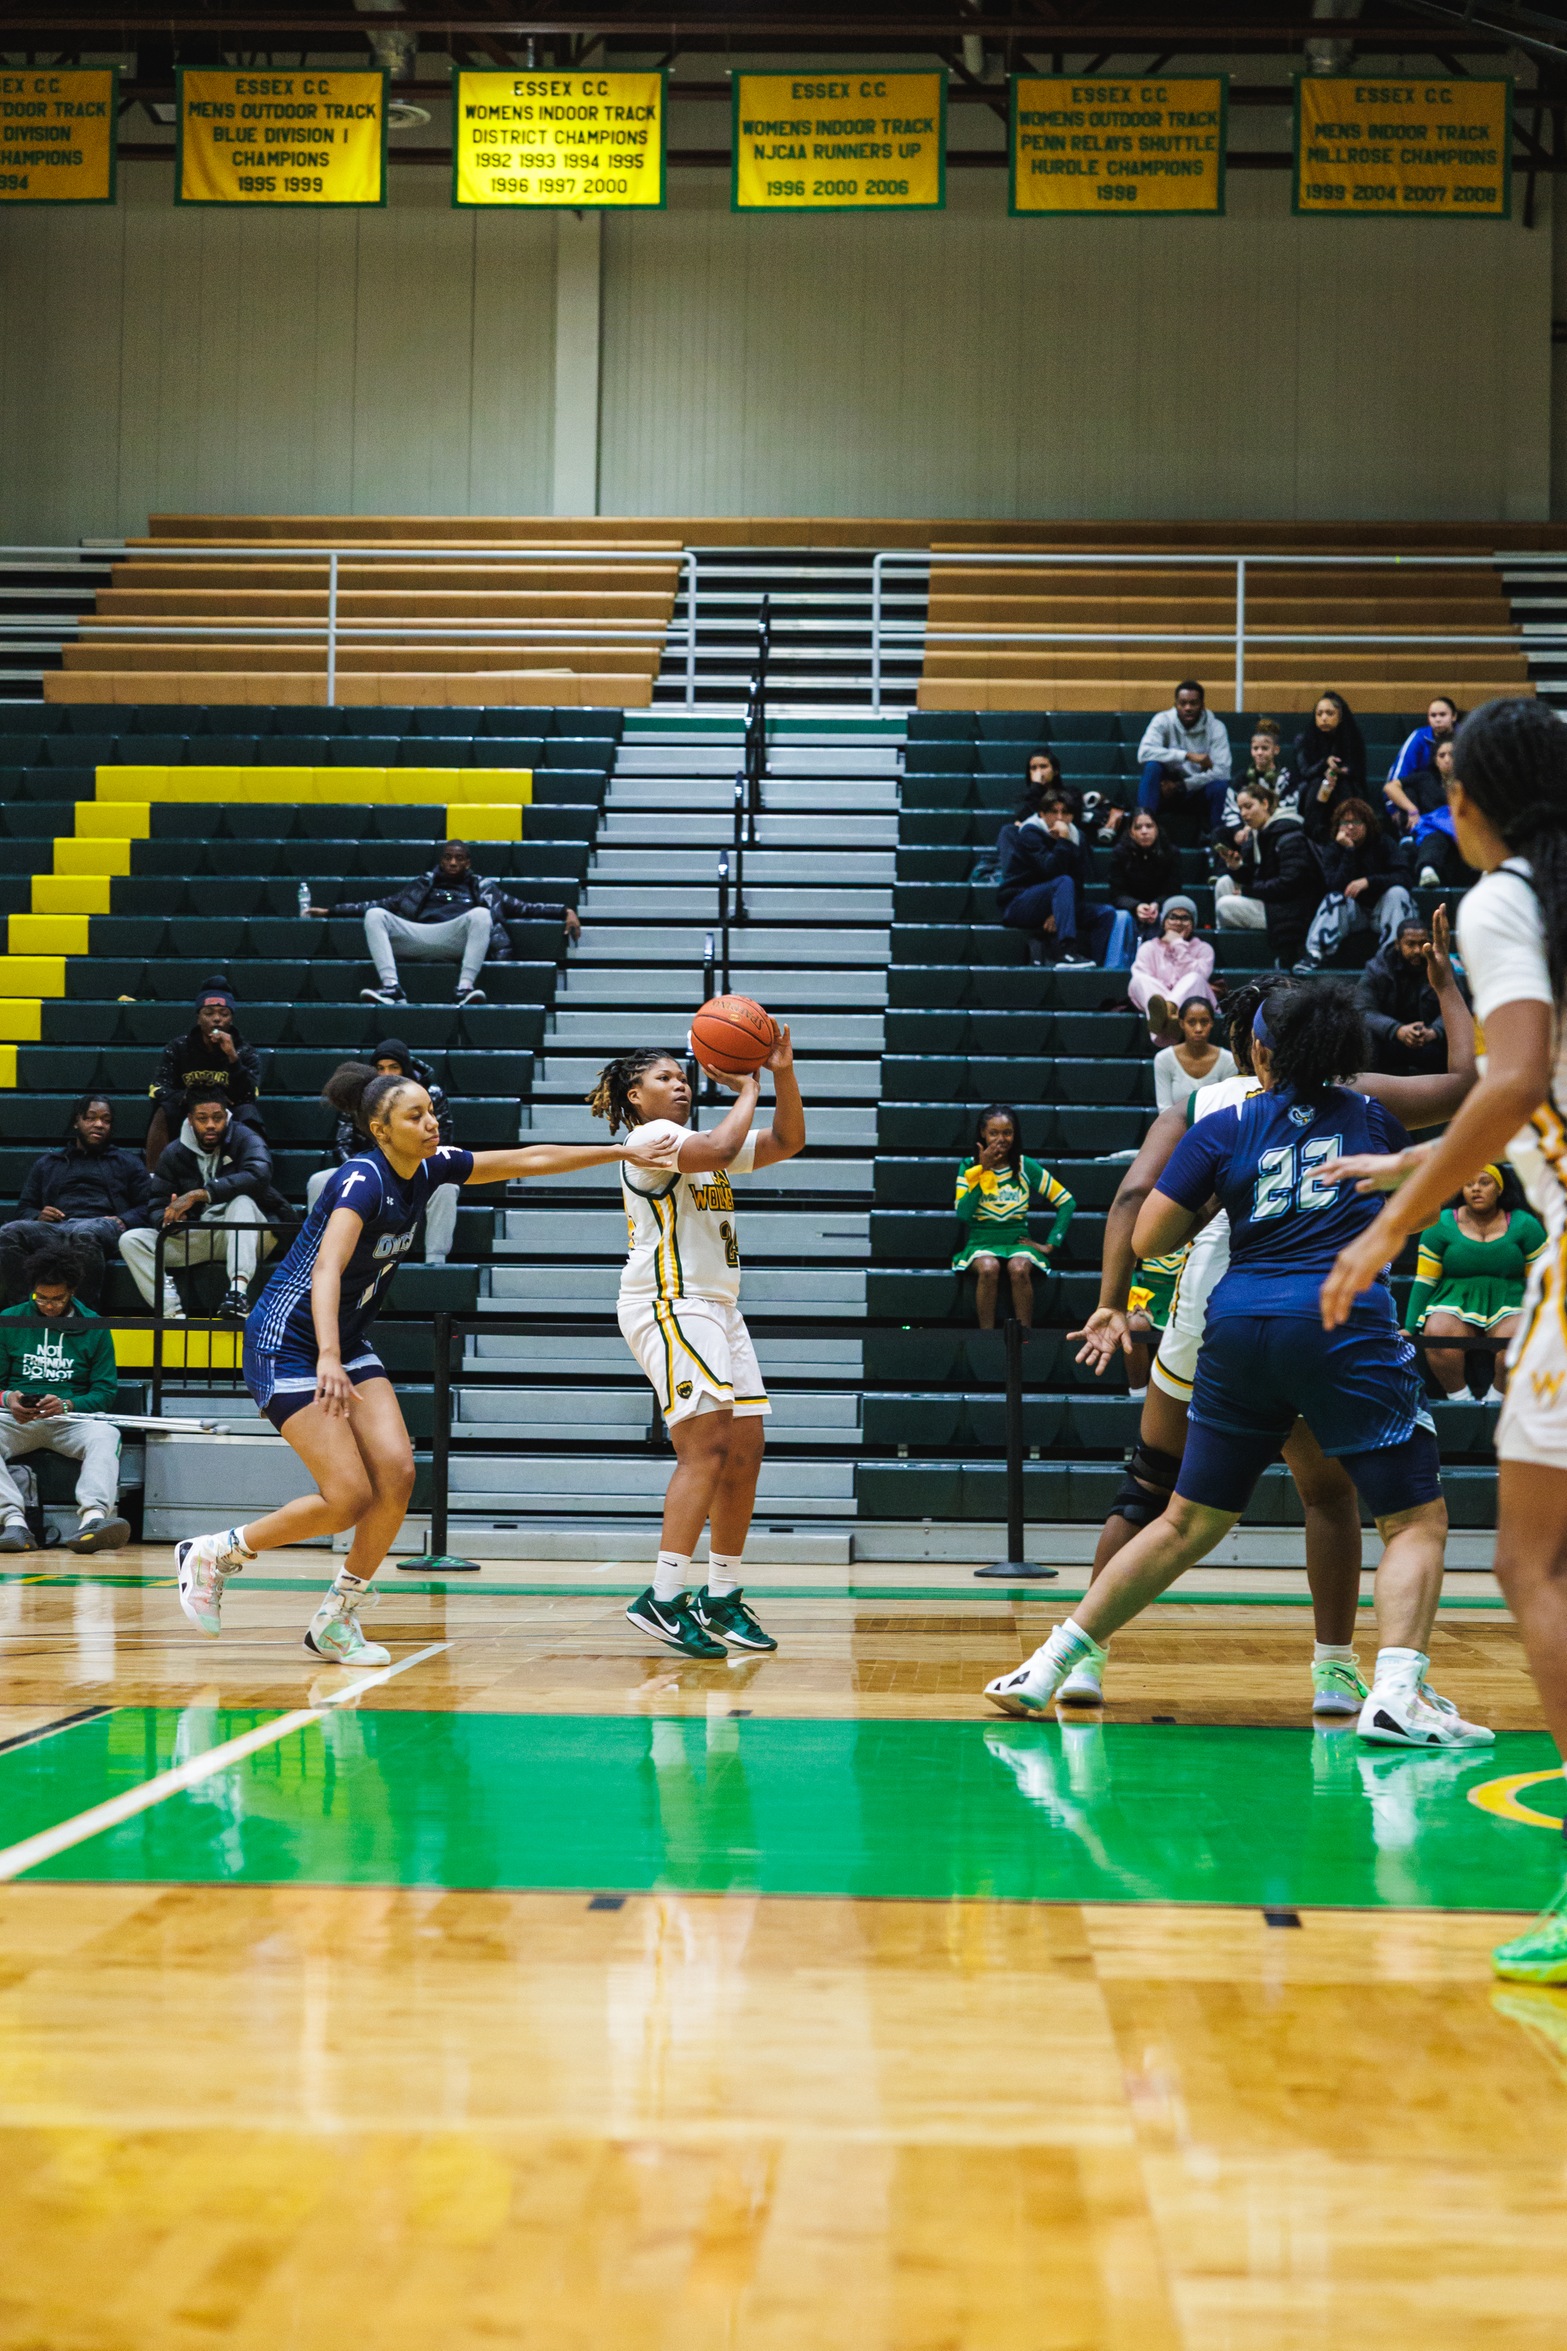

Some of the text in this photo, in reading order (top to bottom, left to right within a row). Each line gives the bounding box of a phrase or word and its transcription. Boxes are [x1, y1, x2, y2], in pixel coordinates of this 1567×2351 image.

[235, 79, 294, 95] ESSEX
[513, 80, 572, 96] ESSEX
[791, 82, 850, 99] ESSEX
[1071, 86, 1132, 103] ESSEX
[1354, 86, 1416, 104] ESSEX
[54, 101, 106, 117] TRACK
[188, 102, 376, 119] MENS OUTDOOR TRACK
[465, 105, 656, 121] WOMENS INDOOR TRACK
[742, 118, 934, 136] WOMENS INDOOR TRACK
[1019, 110, 1218, 127] WOMENS OUTDOOR TRACK
[4, 126, 71, 141] DIVISION
[213, 126, 257, 143] BLUE
[265, 127, 335, 143] DIVISION
[473, 129, 648, 145] DISTRICT CHAMPIONS
[1314, 123, 1490, 141] MENS INDOOR TRACK
[753, 142, 922, 160] NJCAA RUNNERS UP
[1020, 134, 1217, 151] PENN RELAYS SHUTTLE
[232, 151, 330, 167] CHAMPIONS
[475, 153, 644, 168] 1992 1993 1994 1995
[1307, 147, 1497, 165] MILLROSE CHAMPIONS
[1031, 159, 1204, 176] HURDLE CHAMPIONS
[238, 176, 323, 192] 1995 1999
[491, 178, 628, 194] 1996 1997 2000
[766, 180, 909, 196] 1996 2000 2006
[1353, 185, 1398, 201] 2004
[1403, 186, 1447, 202] 2007
[1250, 1133, 1343, 1223] 22
[37, 1344, 63, 1357] NOT
[22, 1364, 43, 1375] DO
[46, 1370, 74, 1379] NOT
